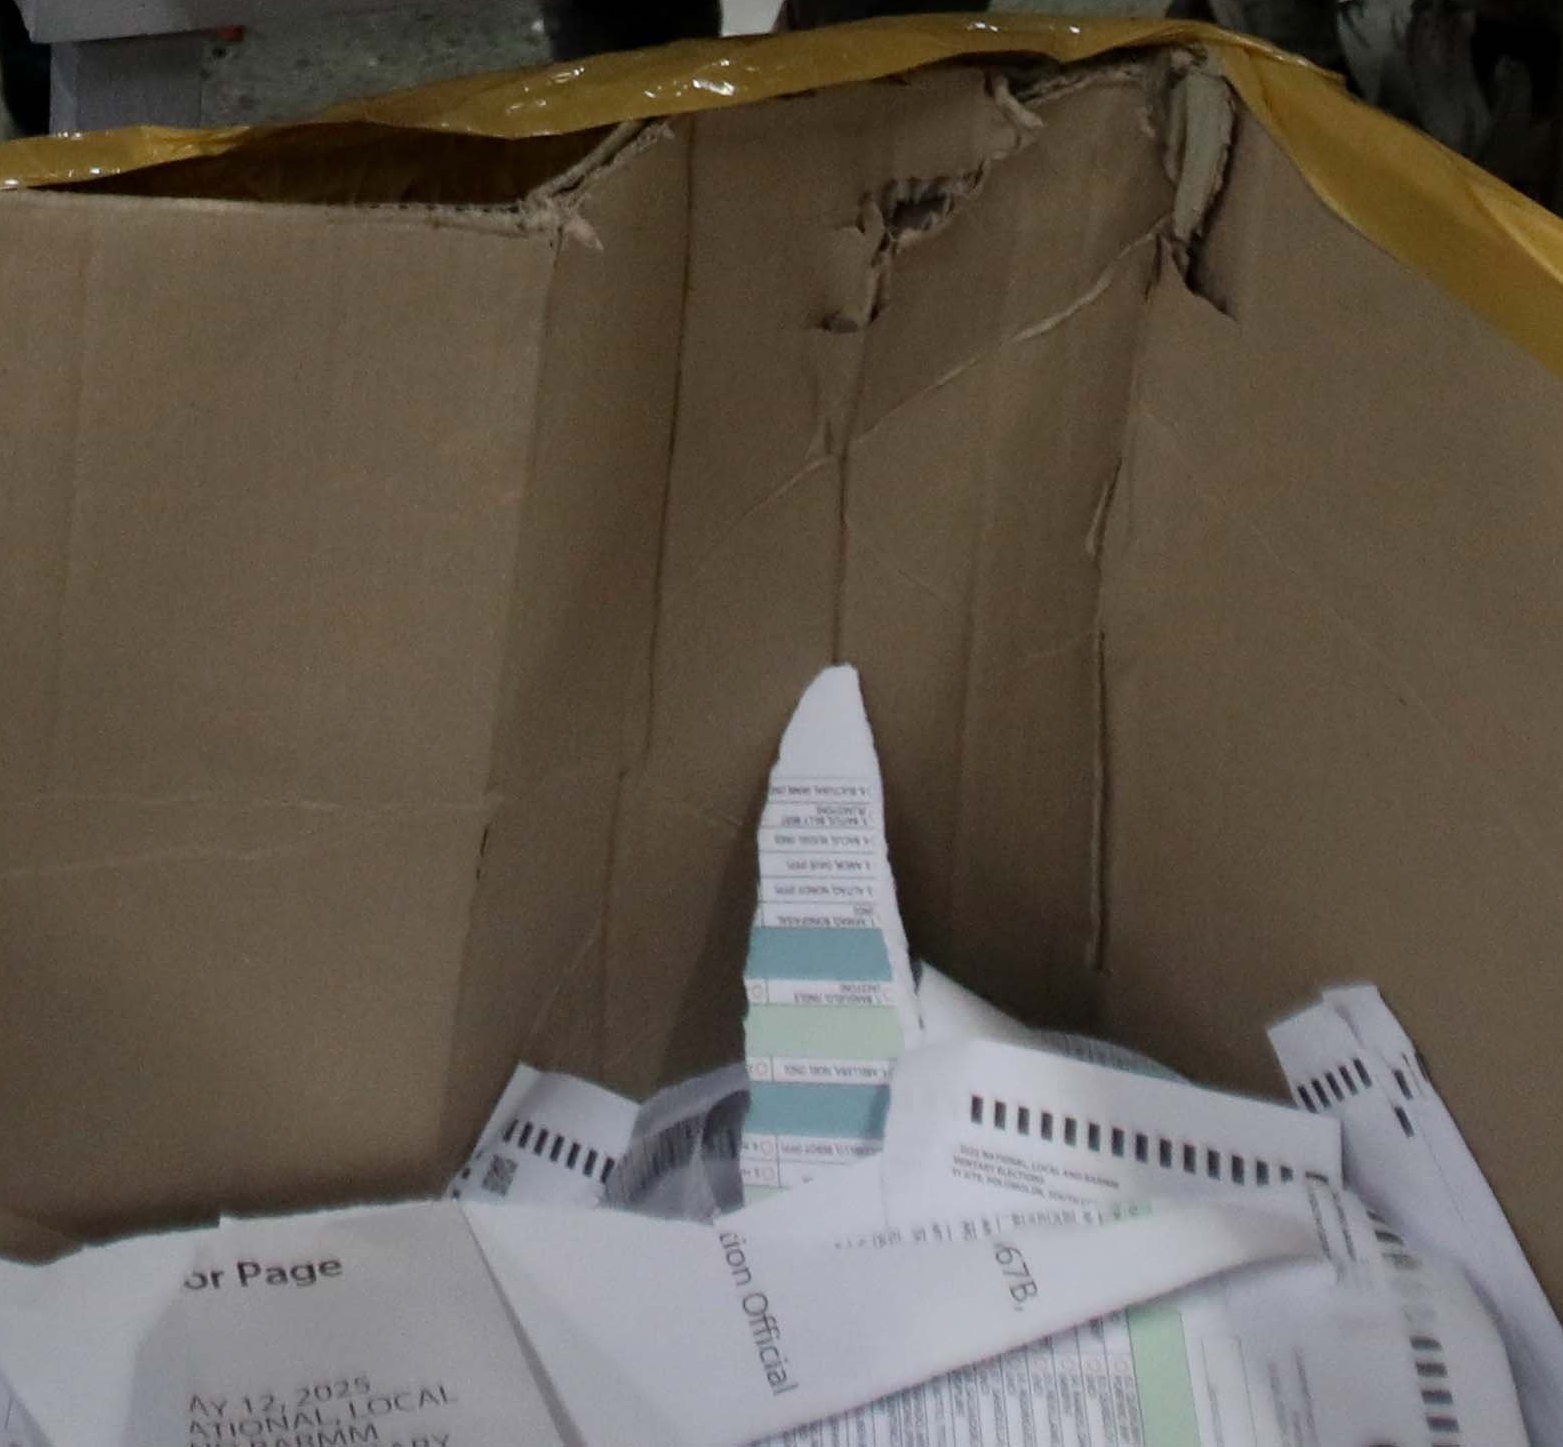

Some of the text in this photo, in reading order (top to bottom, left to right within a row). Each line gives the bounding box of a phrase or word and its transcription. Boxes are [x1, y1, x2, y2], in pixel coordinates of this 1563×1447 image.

[237, 1258, 342, 1287] Page
[742, 1292, 799, 1396] Official
[189, 1394, 228, 1418] AY
[298, 1375, 371, 1406] 2025
[348, 1384, 458, 1418] LOCAL
